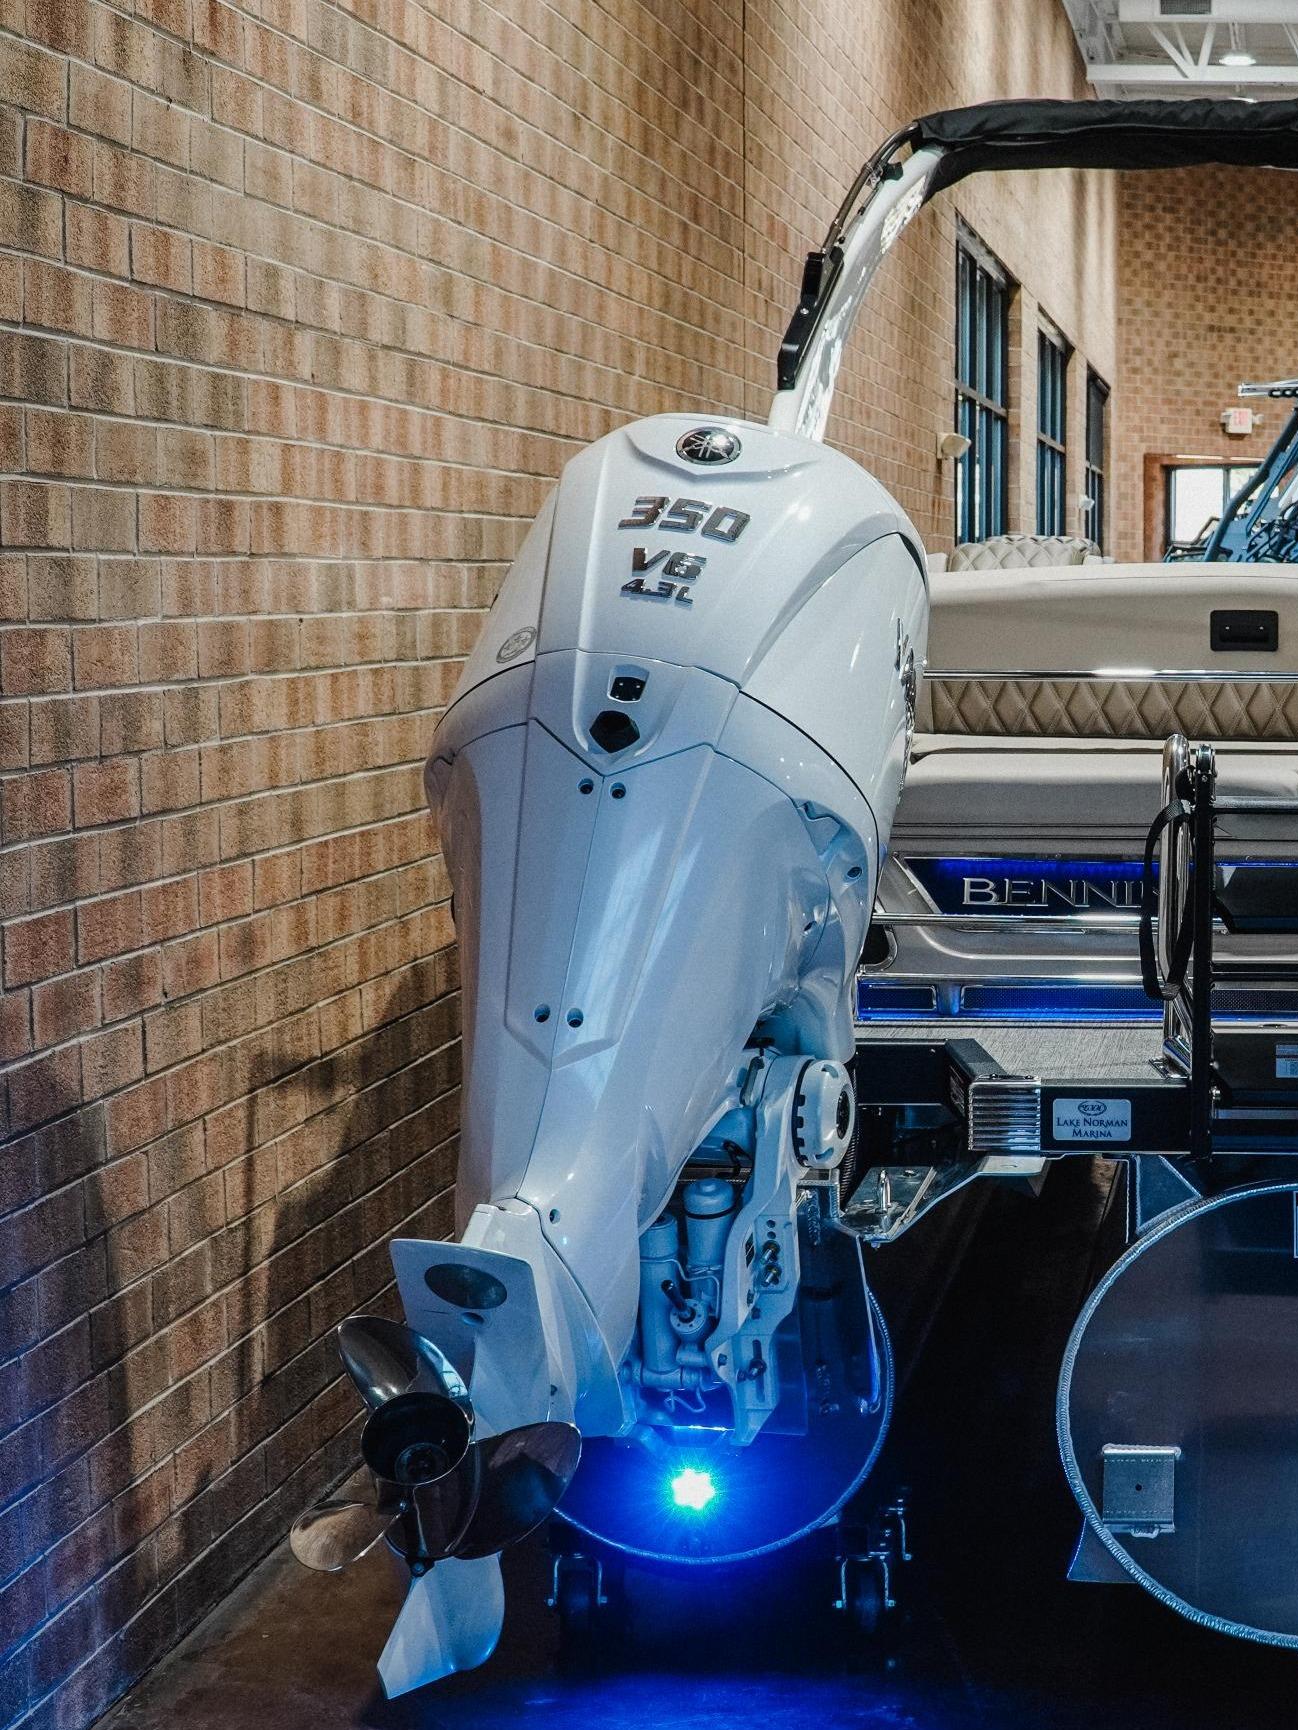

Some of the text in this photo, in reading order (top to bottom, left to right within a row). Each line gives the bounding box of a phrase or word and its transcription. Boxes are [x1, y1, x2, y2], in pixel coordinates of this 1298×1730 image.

[617, 496, 751, 543] 350
[631, 547, 708, 581] V6
[962, 877, 1143, 908] BENNI
[1056, 1117, 1128, 1127] LAKE NORMAN
[1072, 1129, 1112, 1138] MARINA
